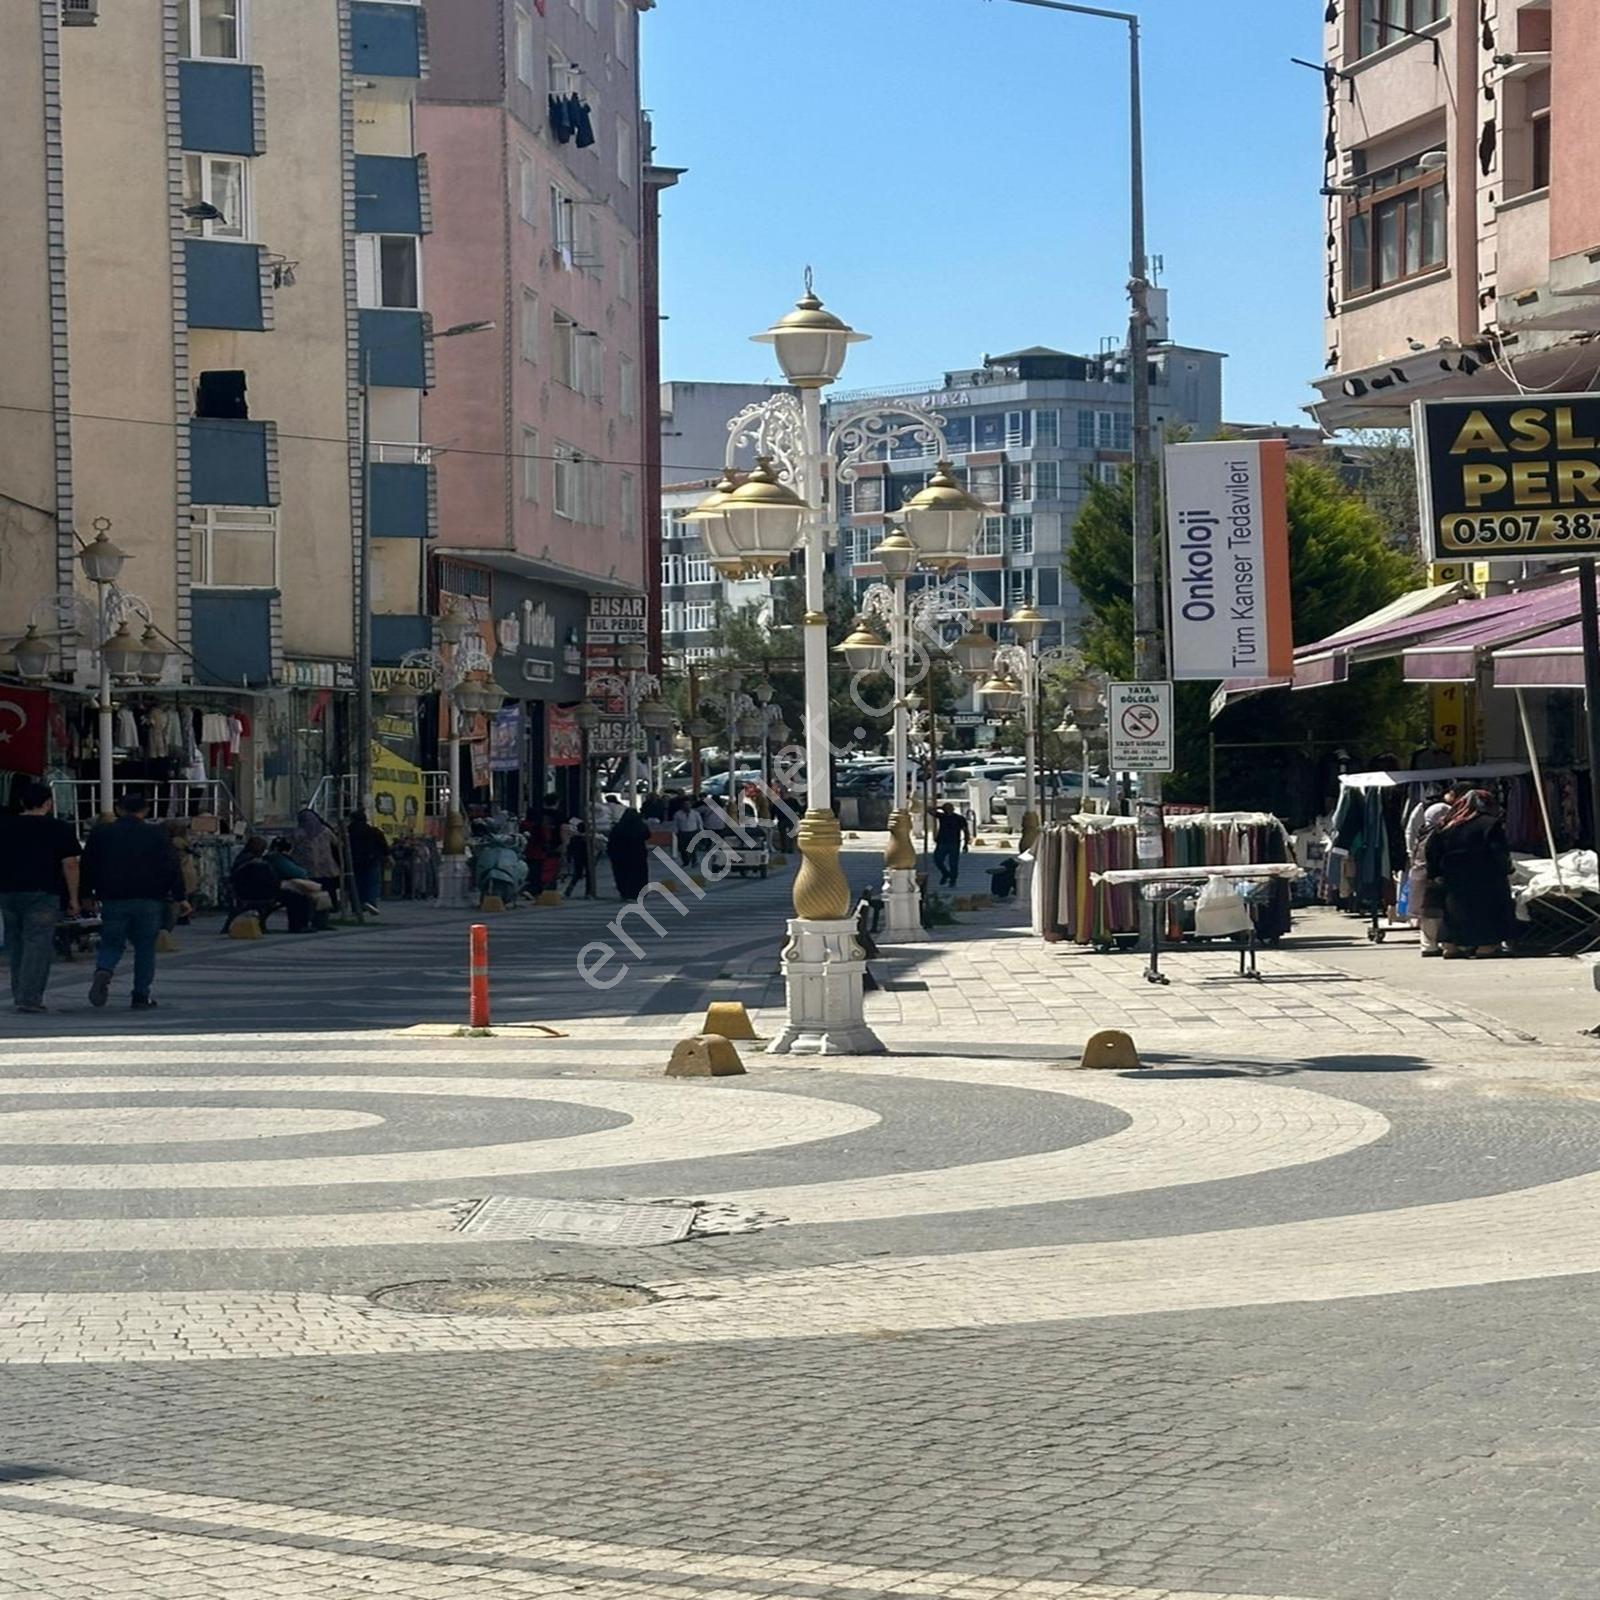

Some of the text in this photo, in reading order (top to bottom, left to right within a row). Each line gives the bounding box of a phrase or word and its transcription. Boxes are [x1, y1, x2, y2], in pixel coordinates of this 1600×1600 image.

[1449, 407, 1600, 454] ASL
[1463, 460, 1600, 507] PER
[1452, 515, 1541, 545] 0507
[1178, 509, 1220, 622] Onkoloji
[1224, 460, 1257, 669] Tüm Kanser Tedavileri
[590, 597, 644, 616] ENSAR
[611, 618, 645, 631] PERDE
[1120, 694, 1160, 704] BÖLGESİ
[1128, 686, 1152, 694] YAYA
